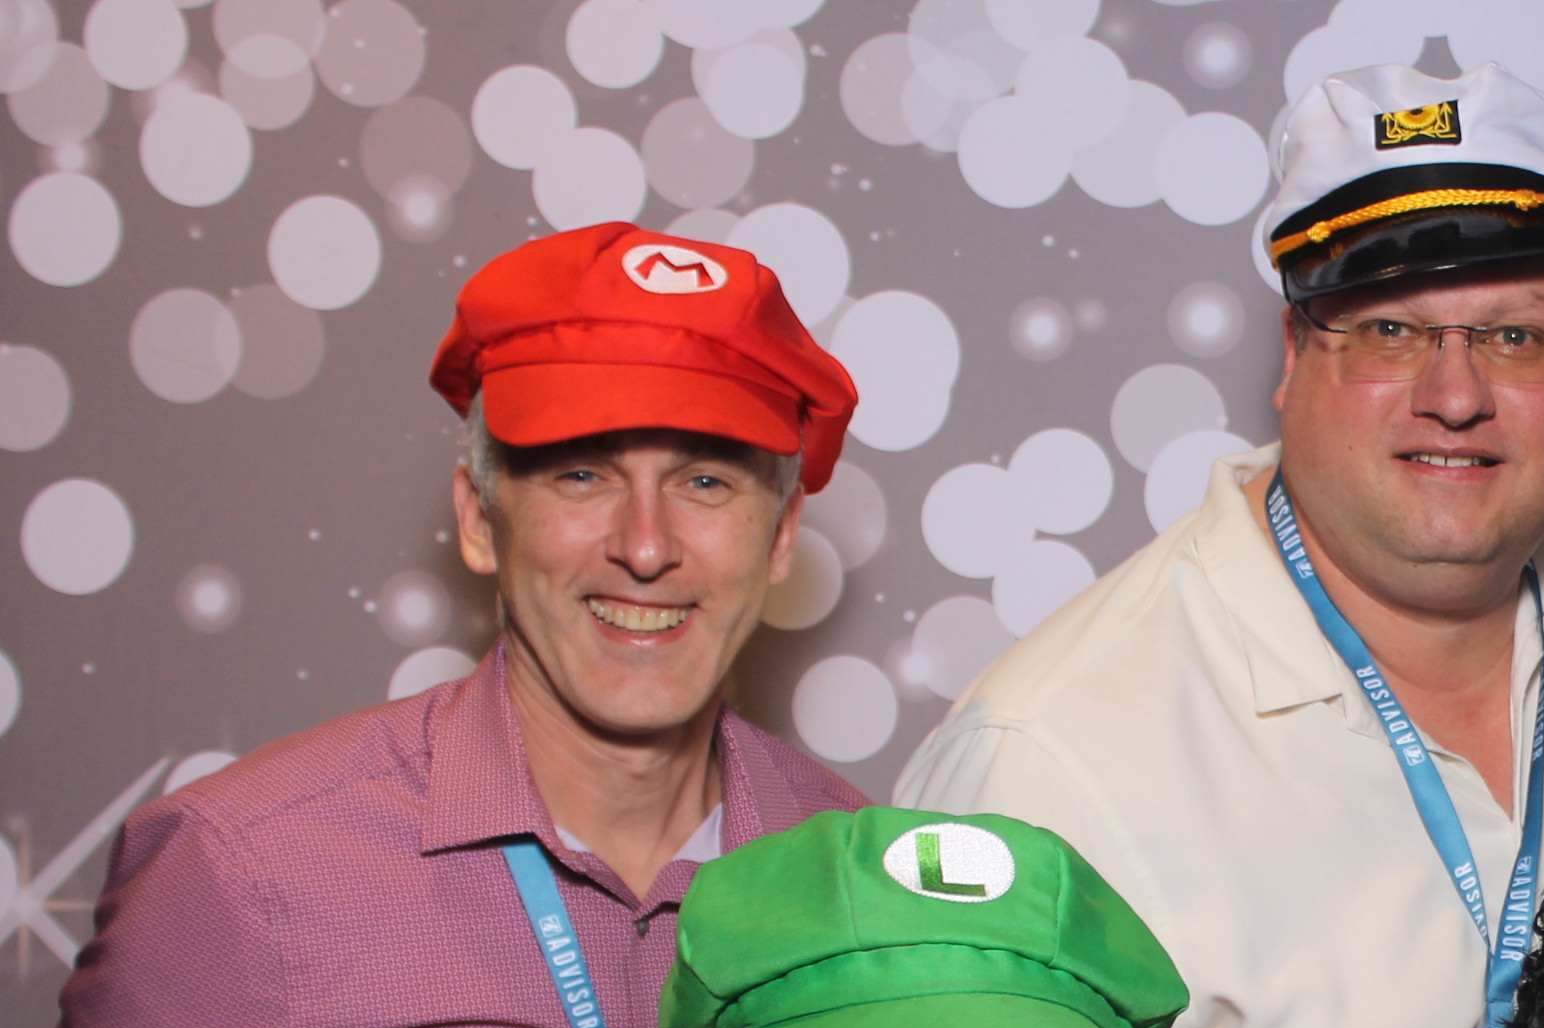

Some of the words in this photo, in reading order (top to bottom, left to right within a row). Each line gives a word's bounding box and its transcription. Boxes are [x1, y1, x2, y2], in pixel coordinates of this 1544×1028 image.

[635, 251, 714, 288] M
[1267, 484, 1306, 562] ADVISOR
[1356, 665, 1416, 745] ADVISOR
[915, 832, 987, 898] L
[1454, 861, 1487, 938] DVISOR
[1500, 876, 1532, 962] ADVISOR
